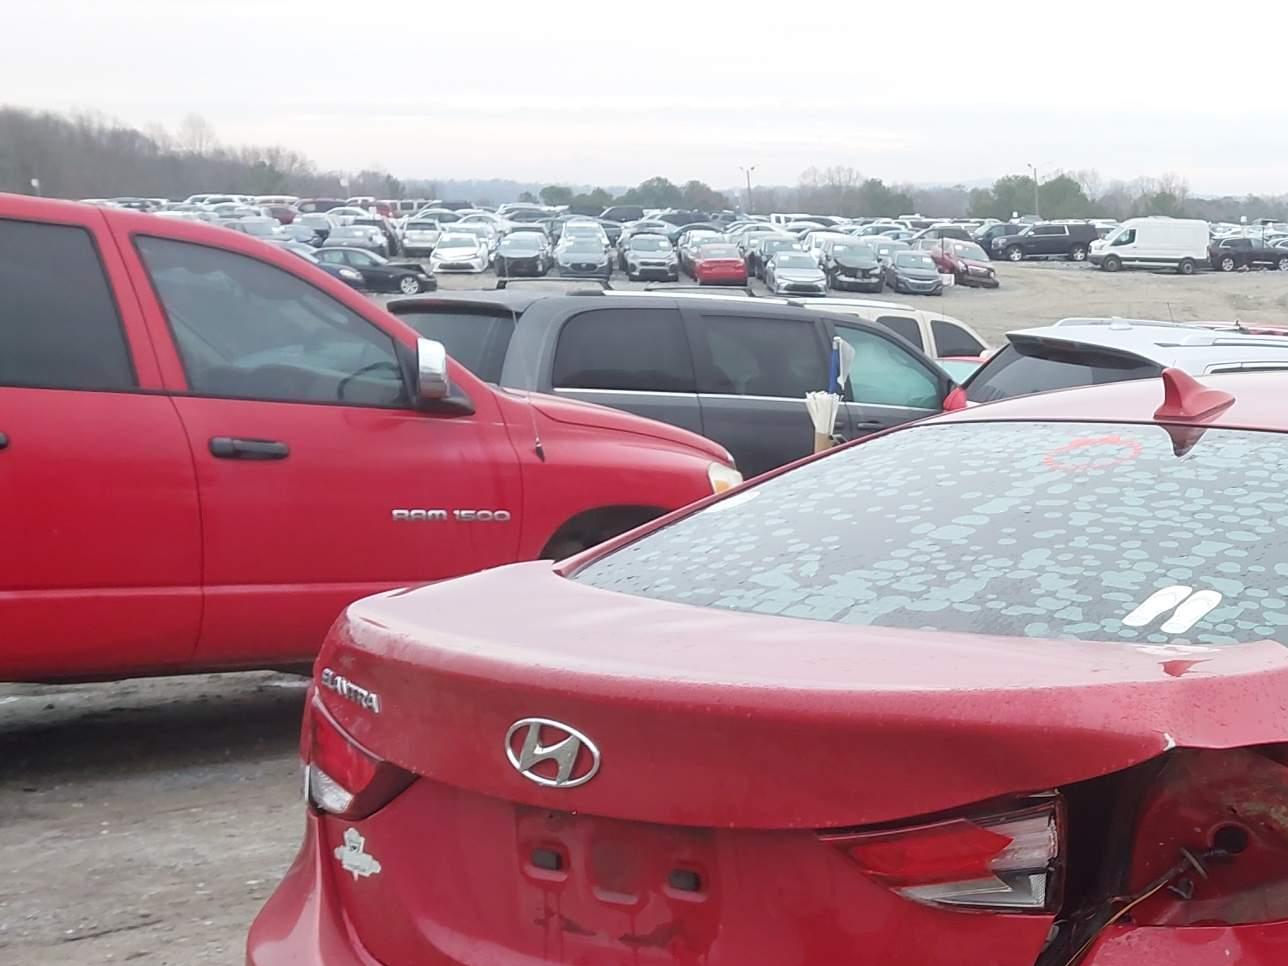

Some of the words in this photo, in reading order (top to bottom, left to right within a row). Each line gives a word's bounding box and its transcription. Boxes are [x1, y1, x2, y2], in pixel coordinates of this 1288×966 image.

[391, 509, 448, 521] RAM
[453, 510, 511, 522] 1500
[322, 667, 380, 714] ELANTRA
